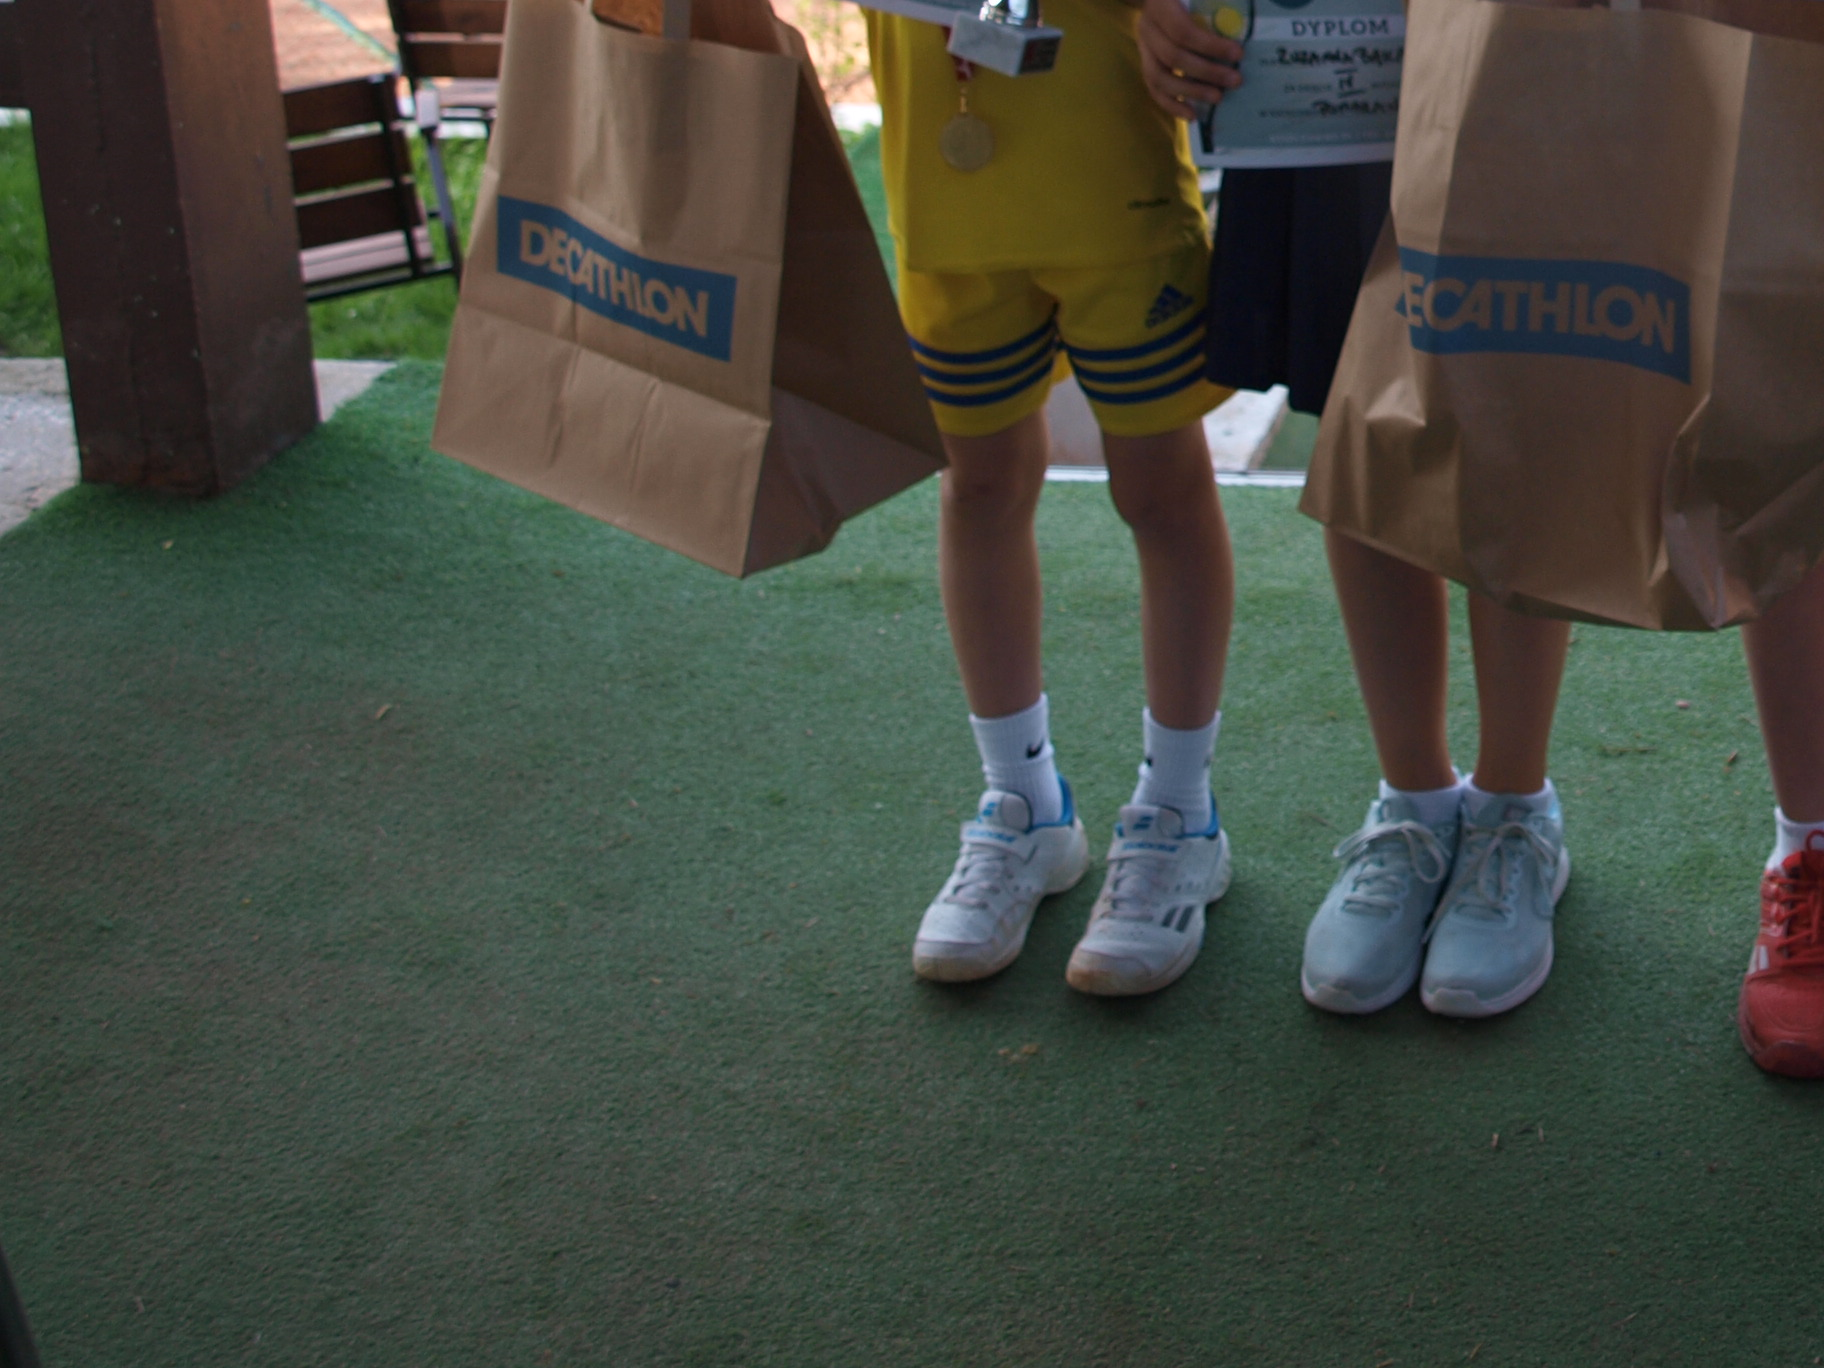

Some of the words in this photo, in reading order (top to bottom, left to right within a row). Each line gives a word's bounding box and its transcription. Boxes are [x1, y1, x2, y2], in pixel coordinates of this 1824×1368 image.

[1292, 18, 1389, 37] DYPLOM
[519, 218, 711, 339] DECATHLON
[1401, 270, 1676, 353] ECATHLON
